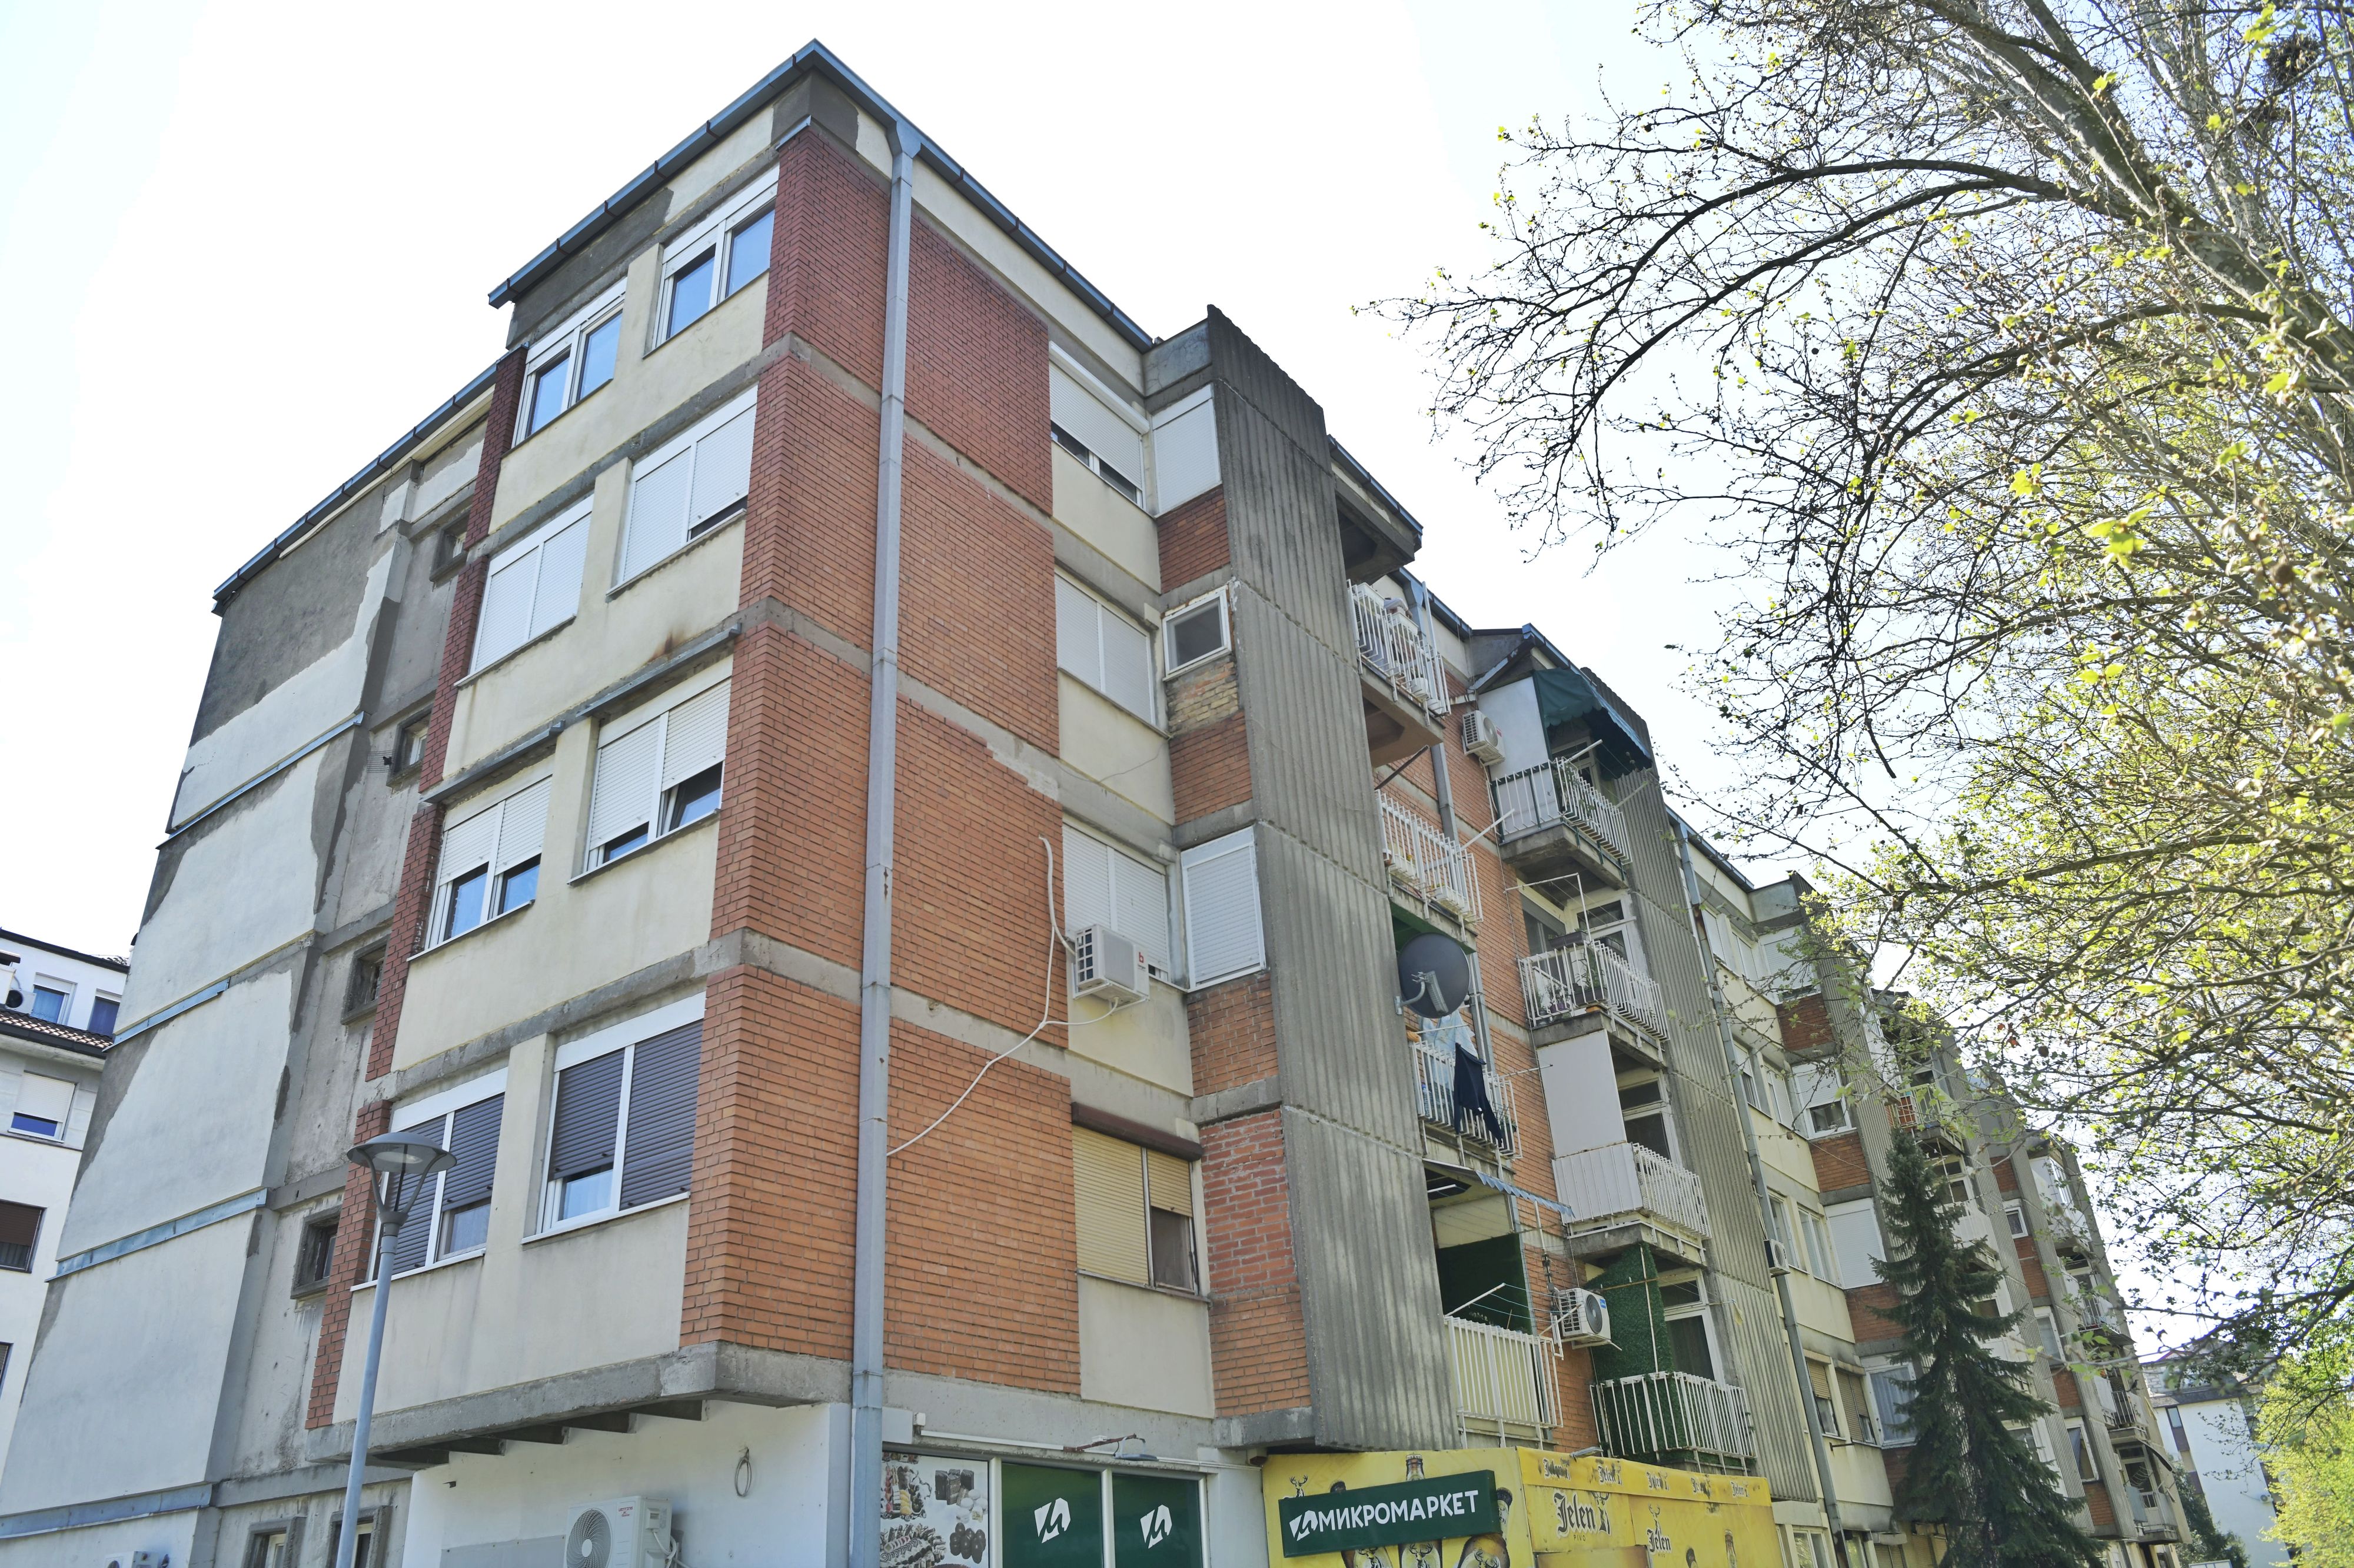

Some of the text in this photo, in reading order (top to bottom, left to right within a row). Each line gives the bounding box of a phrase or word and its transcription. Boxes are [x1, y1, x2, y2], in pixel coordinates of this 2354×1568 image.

[1318, 1490, 1478, 1532] МИКРОМАРКЕТ
[1554, 1492, 1596, 1534] Jelen
[1647, 1529, 1671, 1552] Jelen
